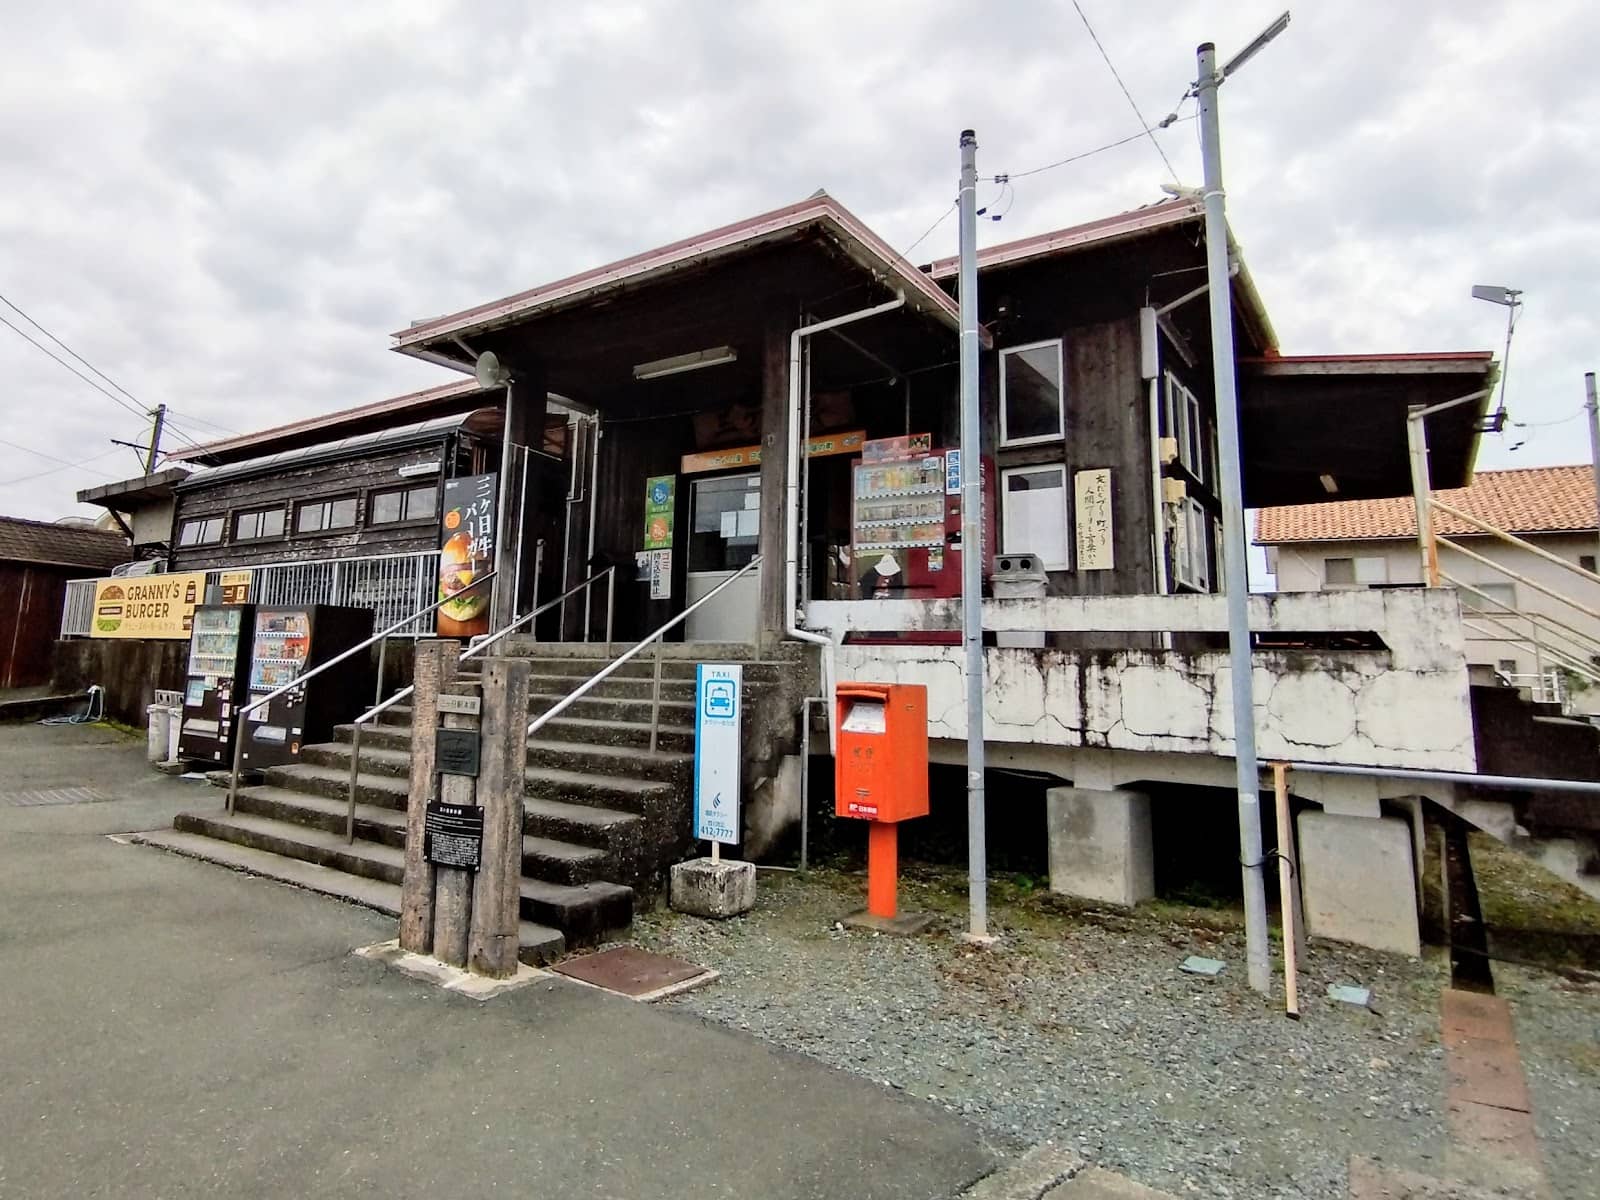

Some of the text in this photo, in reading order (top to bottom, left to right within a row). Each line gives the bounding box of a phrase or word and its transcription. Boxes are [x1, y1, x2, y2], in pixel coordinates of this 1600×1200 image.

[464, 502, 478, 576] バーガー
[662, 551, 671, 570] ゴミ
[128, 579, 180, 600] GRANNY'S
[126, 602, 169, 619] BURGER
